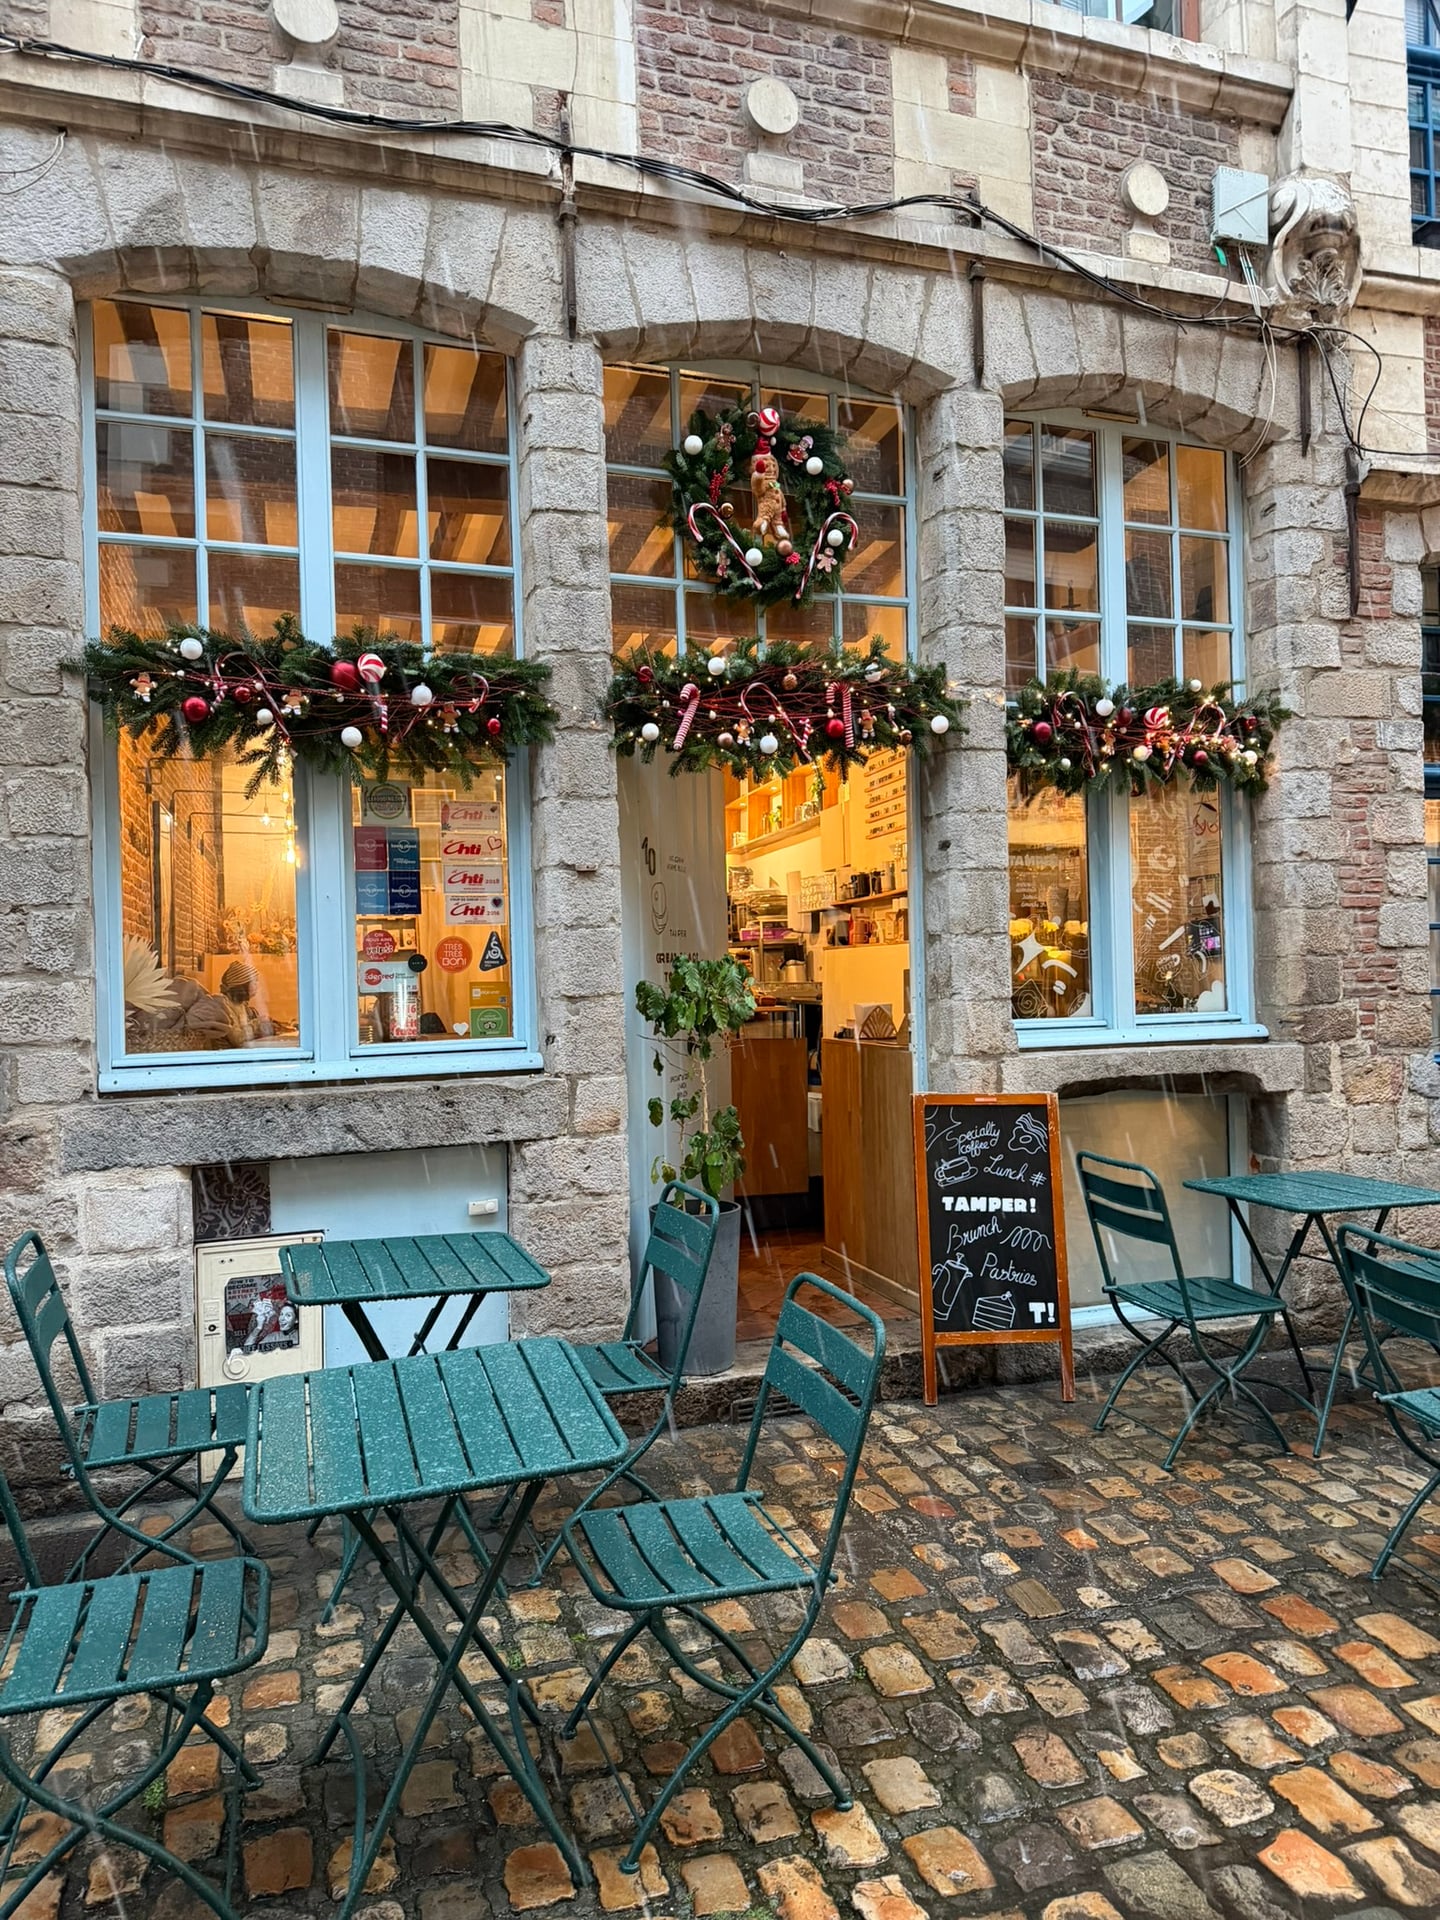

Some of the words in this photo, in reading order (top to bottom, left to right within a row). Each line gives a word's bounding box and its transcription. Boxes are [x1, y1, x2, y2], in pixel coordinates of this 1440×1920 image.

[641, 836, 656, 875] 10
[946, 1121, 1001, 1155] Specialty
[960, 1140, 990, 1157] coffee
[983, 1154, 1028, 1182] Lunch
[946, 1215, 1003, 1254] Brunch
[980, 1252, 1038, 1287] Pastries
[1028, 1302, 1056, 1324] T!
